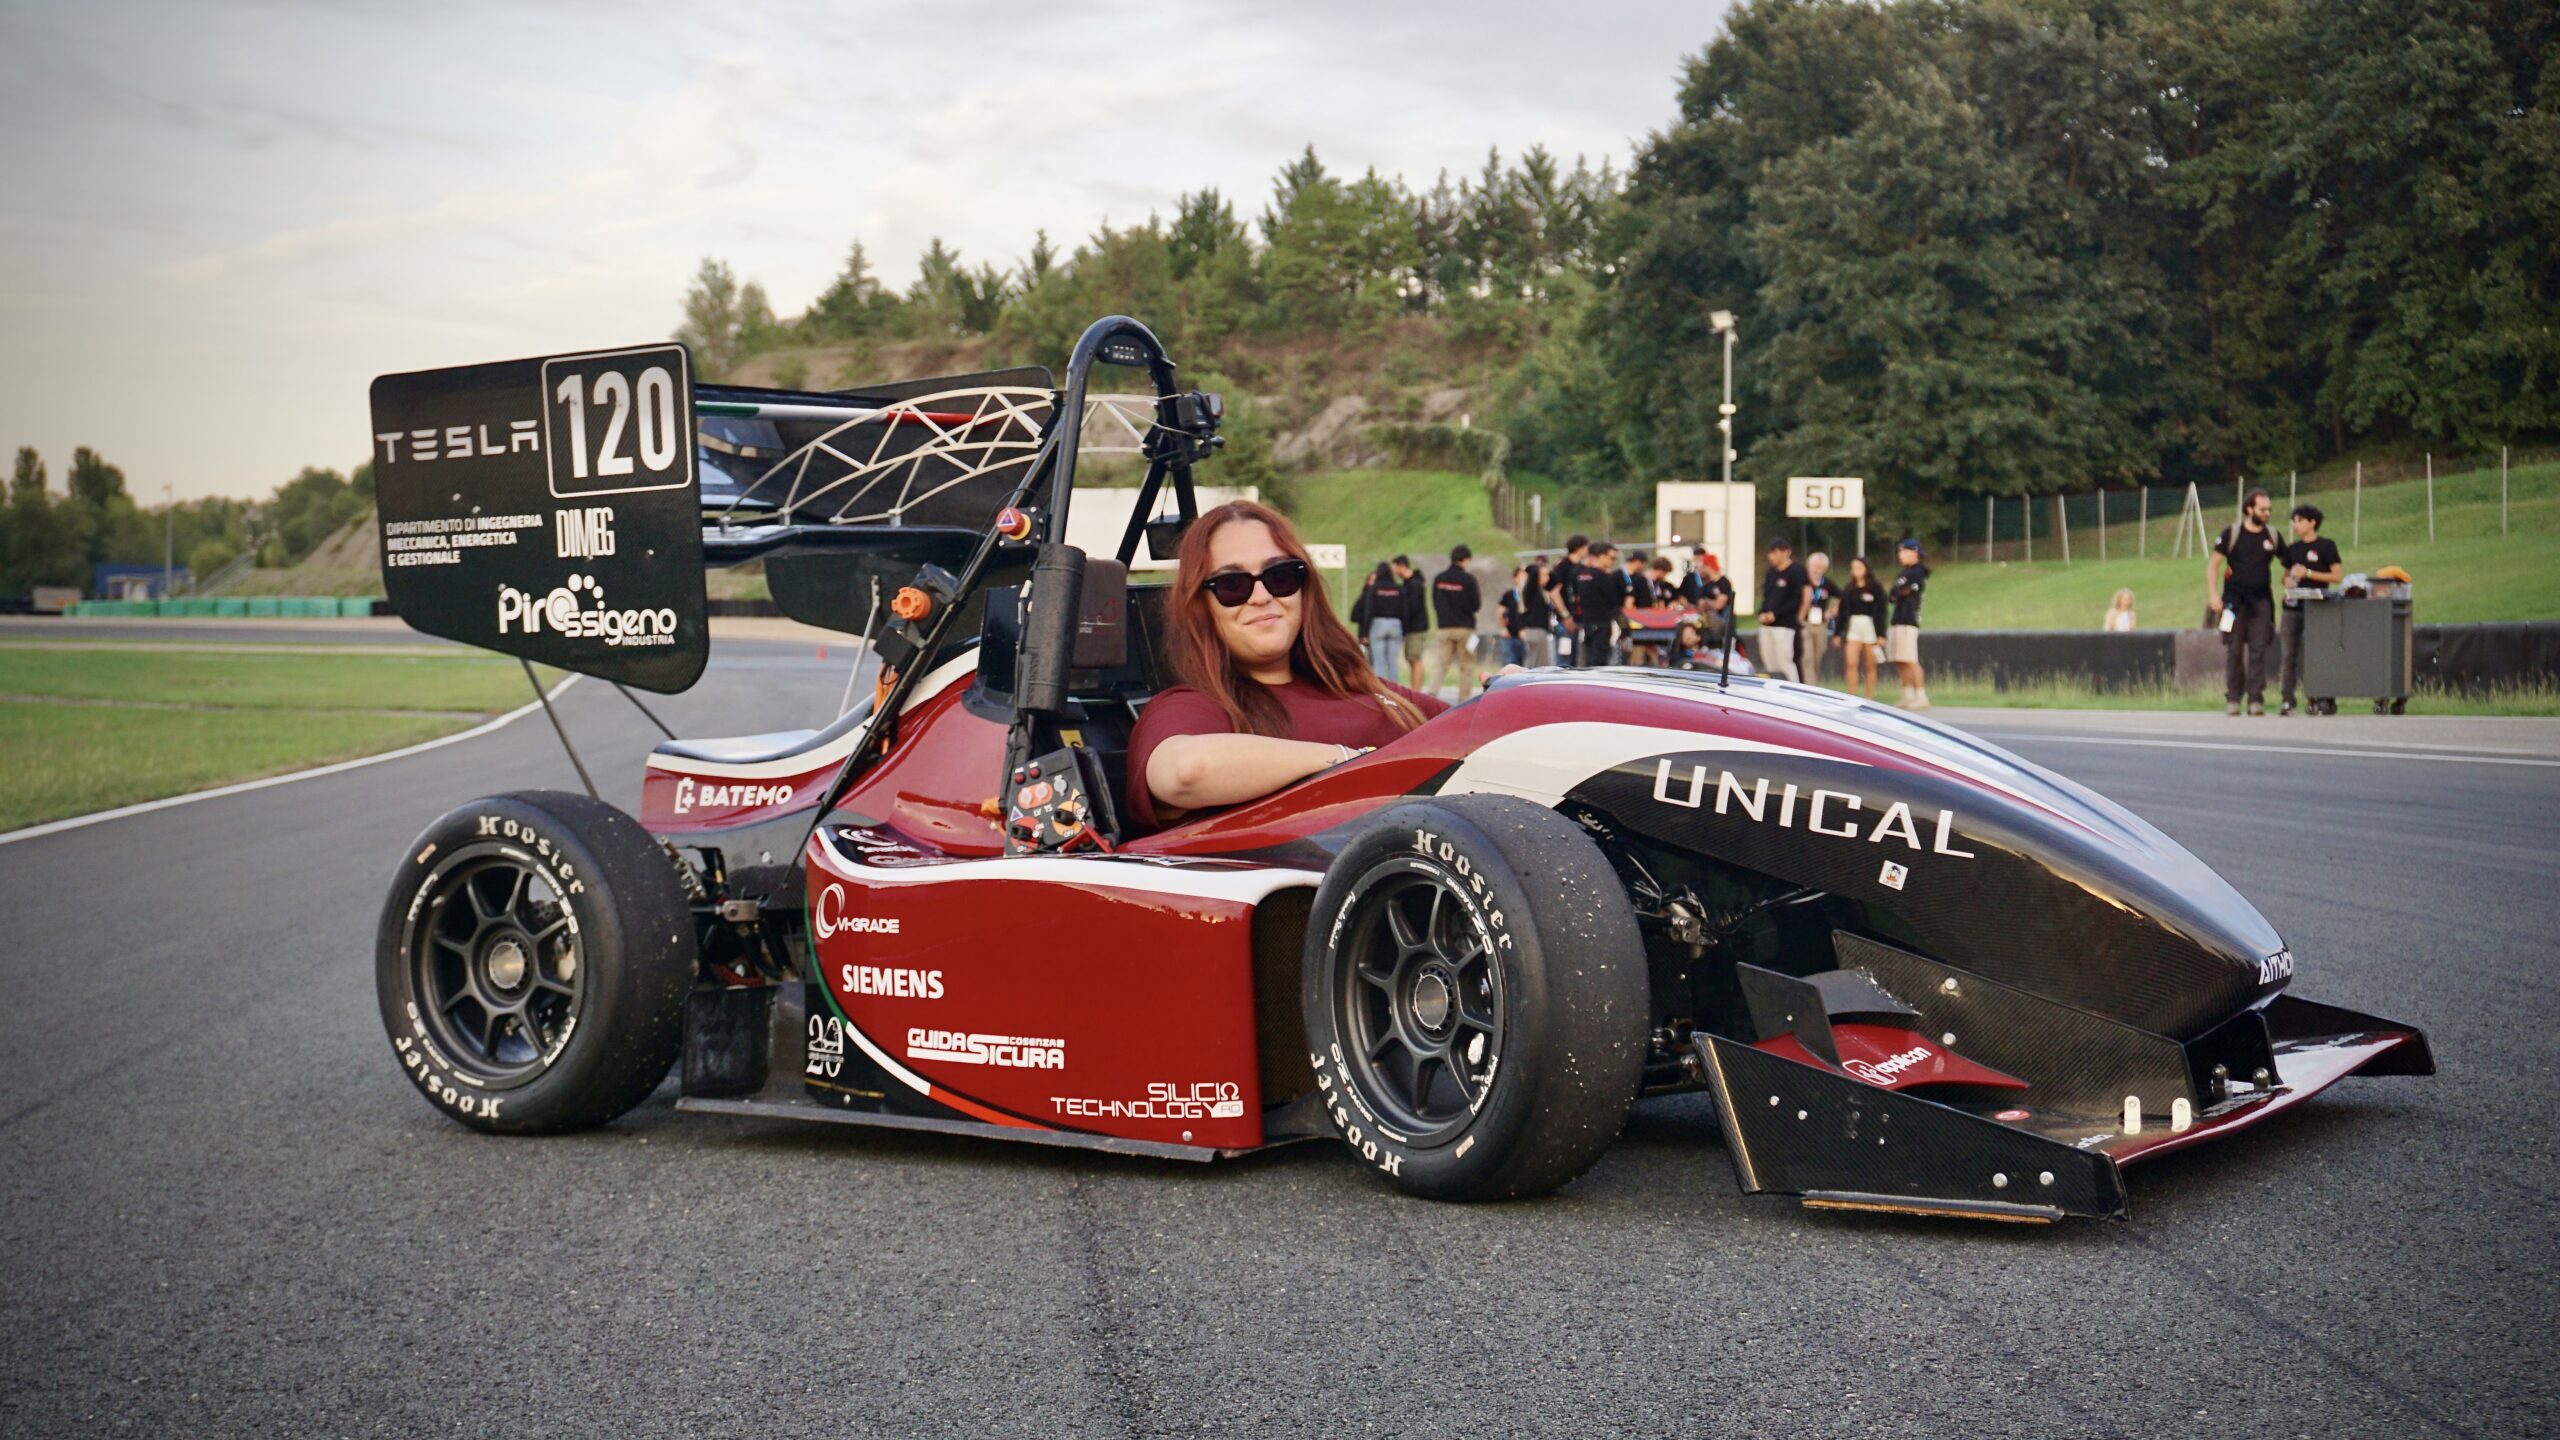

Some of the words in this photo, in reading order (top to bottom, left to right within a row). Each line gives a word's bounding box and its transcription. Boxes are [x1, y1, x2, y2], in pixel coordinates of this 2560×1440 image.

[557, 366, 677, 478] 120
[376, 420, 540, 464] TESLA
[1805, 485, 1845, 509] 50
[386, 518, 463, 536] DIPARTIMENTO
[464, 518, 477, 531] DI
[477, 513, 543, 530] INGEGNERIA
[556, 507, 616, 558] DIMEG
[387, 535, 450, 551] MECCANICA,
[451, 531, 518, 548] ENERGETICA
[388, 553, 396, 567] E
[397, 550, 461, 567] GESTIONALE
[622, 635, 675, 647] INDUSTRIA
[699, 785, 793, 807] BATEMO
[1653, 758, 1974, 858] UNICAL
[836, 916, 900, 934] VI-GRADE
[842, 964, 944, 999] SIEMENS
[907, 1028, 967, 1052] GUIDA
[1009, 1036, 1057, 1048] COSENZA
[1874, 1046, 1932, 1073] applicon
[1050, 1096, 1221, 1118] TECHNOLOGY
